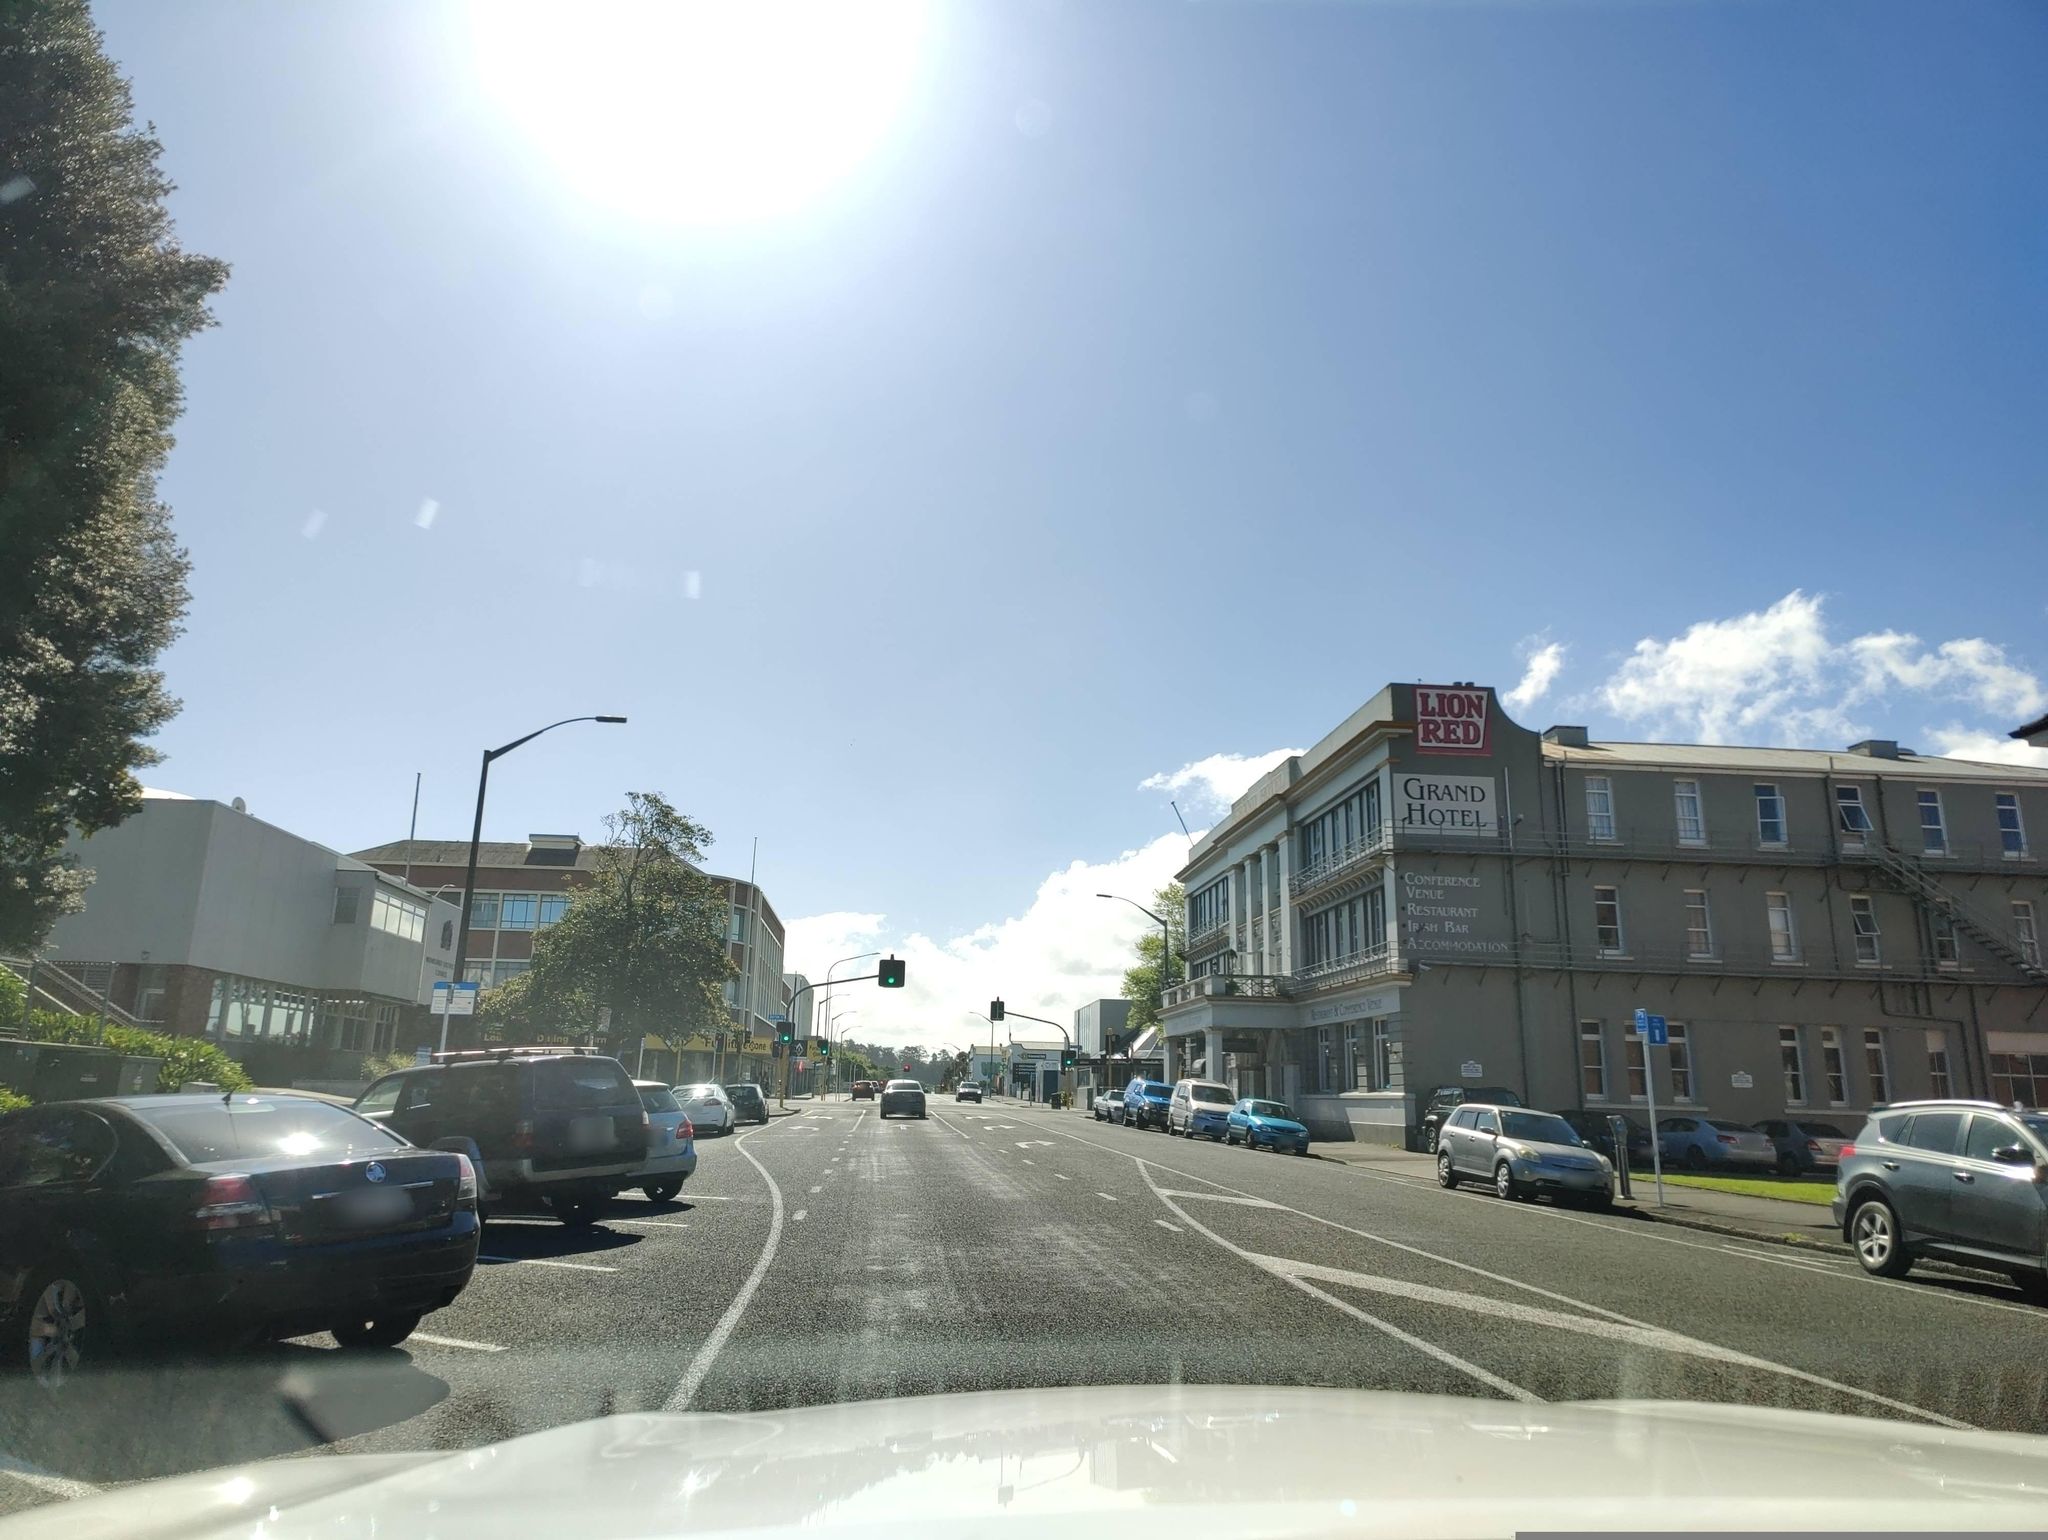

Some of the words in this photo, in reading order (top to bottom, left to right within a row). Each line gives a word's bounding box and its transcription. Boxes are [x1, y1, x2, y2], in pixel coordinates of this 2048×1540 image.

[1419, 692, 1484, 719] LION
[1419, 718, 1482, 745] RED
[1404, 777, 1486, 803] GRAND
[1407, 802, 1488, 828] HOTEL
[1404, 871, 1481, 888] CONFERENCE
[1406, 886, 1445, 900] VENUE
[1407, 902, 1480, 918] RESTAURANT
[1444, 920, 1470, 934] BAR
[1407, 936, 1509, 953] ACCOMMODATION
